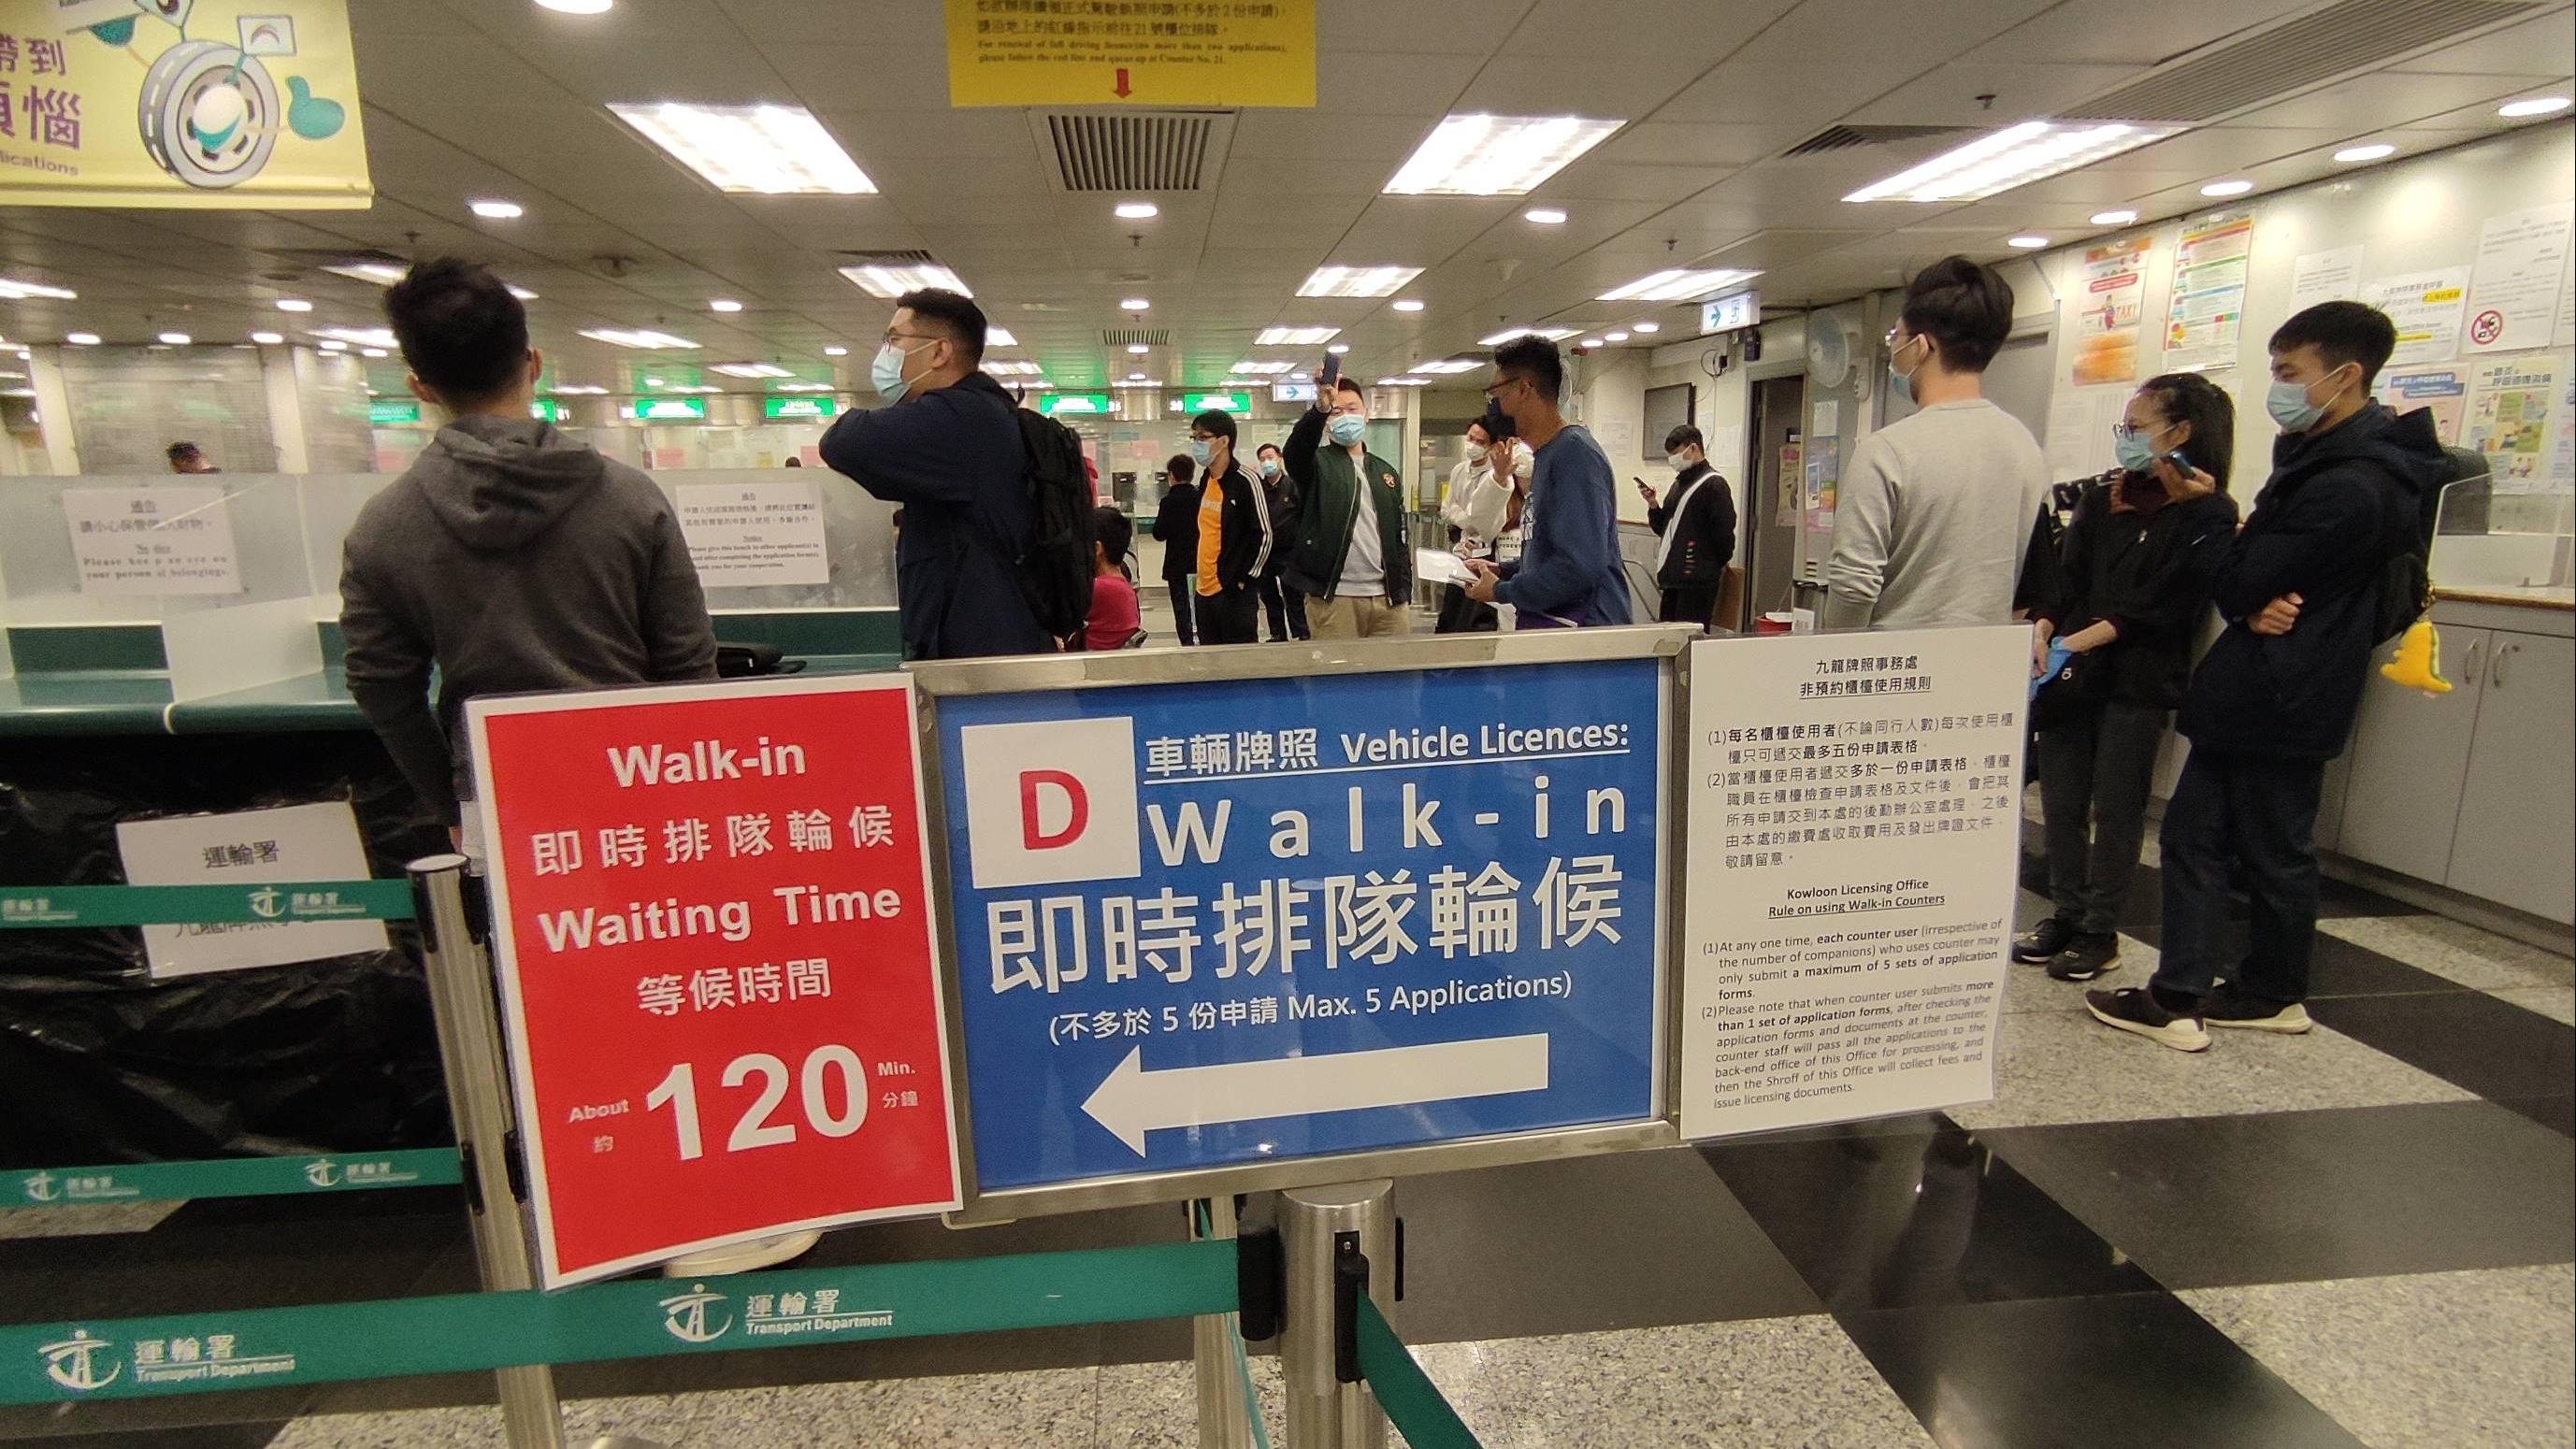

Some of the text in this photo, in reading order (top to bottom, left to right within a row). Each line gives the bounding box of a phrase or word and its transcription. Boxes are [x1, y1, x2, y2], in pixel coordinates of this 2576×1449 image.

[1816, 655, 1918, 675] 九龍牌照事務處
[607, 737, 806, 789] Walk-in
[1144, 721, 1629, 778] 車輛牌照 Vehicle Licences:
[1020, 769, 1088, 851] D
[202, 839, 280, 868] 運輸署
[532, 804, 894, 877] 即時排隊輪候
[1769, 895, 1945, 917] Rule on using Walk-in Counters
[1788, 880, 1929, 899] Kowloon Licensing Office
[538, 884, 902, 955] Waiting Time
[986, 854, 1624, 995] 即時排隊輪候
[1736, 941, 1757, 952] any
[1760, 940, 1781, 948] one
[1785, 937, 1813, 947] time,
[1817, 933, 1843, 944] each
[1847, 930, 1891, 941] counter
[1894, 928, 1919, 937] user
[1991, 918, 2003, 929] of
[1719, 951, 1997, 984] only submit a maximum of 5 sets of application
[1720, 936, 2000, 968] the number of companions) who uses counter may
[637, 957, 831, 1017] 等候時間
[1719, 989, 1756, 1000] forms.
[1759, 1001, 1784, 1012] note
[1789, 998, 1810, 1010] that
[1815, 996, 1845, 1006] when
[1849, 991, 1892, 1003] counter
[1895, 989, 1918, 998] user
[1921, 983, 1962, 997] submits
[1965, 981, 1994, 991] more
[1048, 970, 1574, 1046] (不多於 5 份申請 Max. 5 Applications)
[1718, 995, 1991, 1032] than 1 set of application forms, after checking the
[1716, 1023, 1986, 1063] counter staff will pass all the applications to the
[1717, 1010, 1988, 1048] application forms and documents at the counter,
[1715, 1051, 1982, 1094] then the Shroff of this Office will collect fees and
[1716, 1037, 1984, 1078] back-end office of this Office for processing, and
[568, 1044, 917, 1162] About 120 Min.
[882, 1089, 919, 1109] 分鐘
[1713, 1083, 1855, 1109] issue licensing documents.
[591, 1135, 614, 1154] 約
[746, 1289, 840, 1318] 運輸署
[746, 1314, 894, 1335] Transport Department
